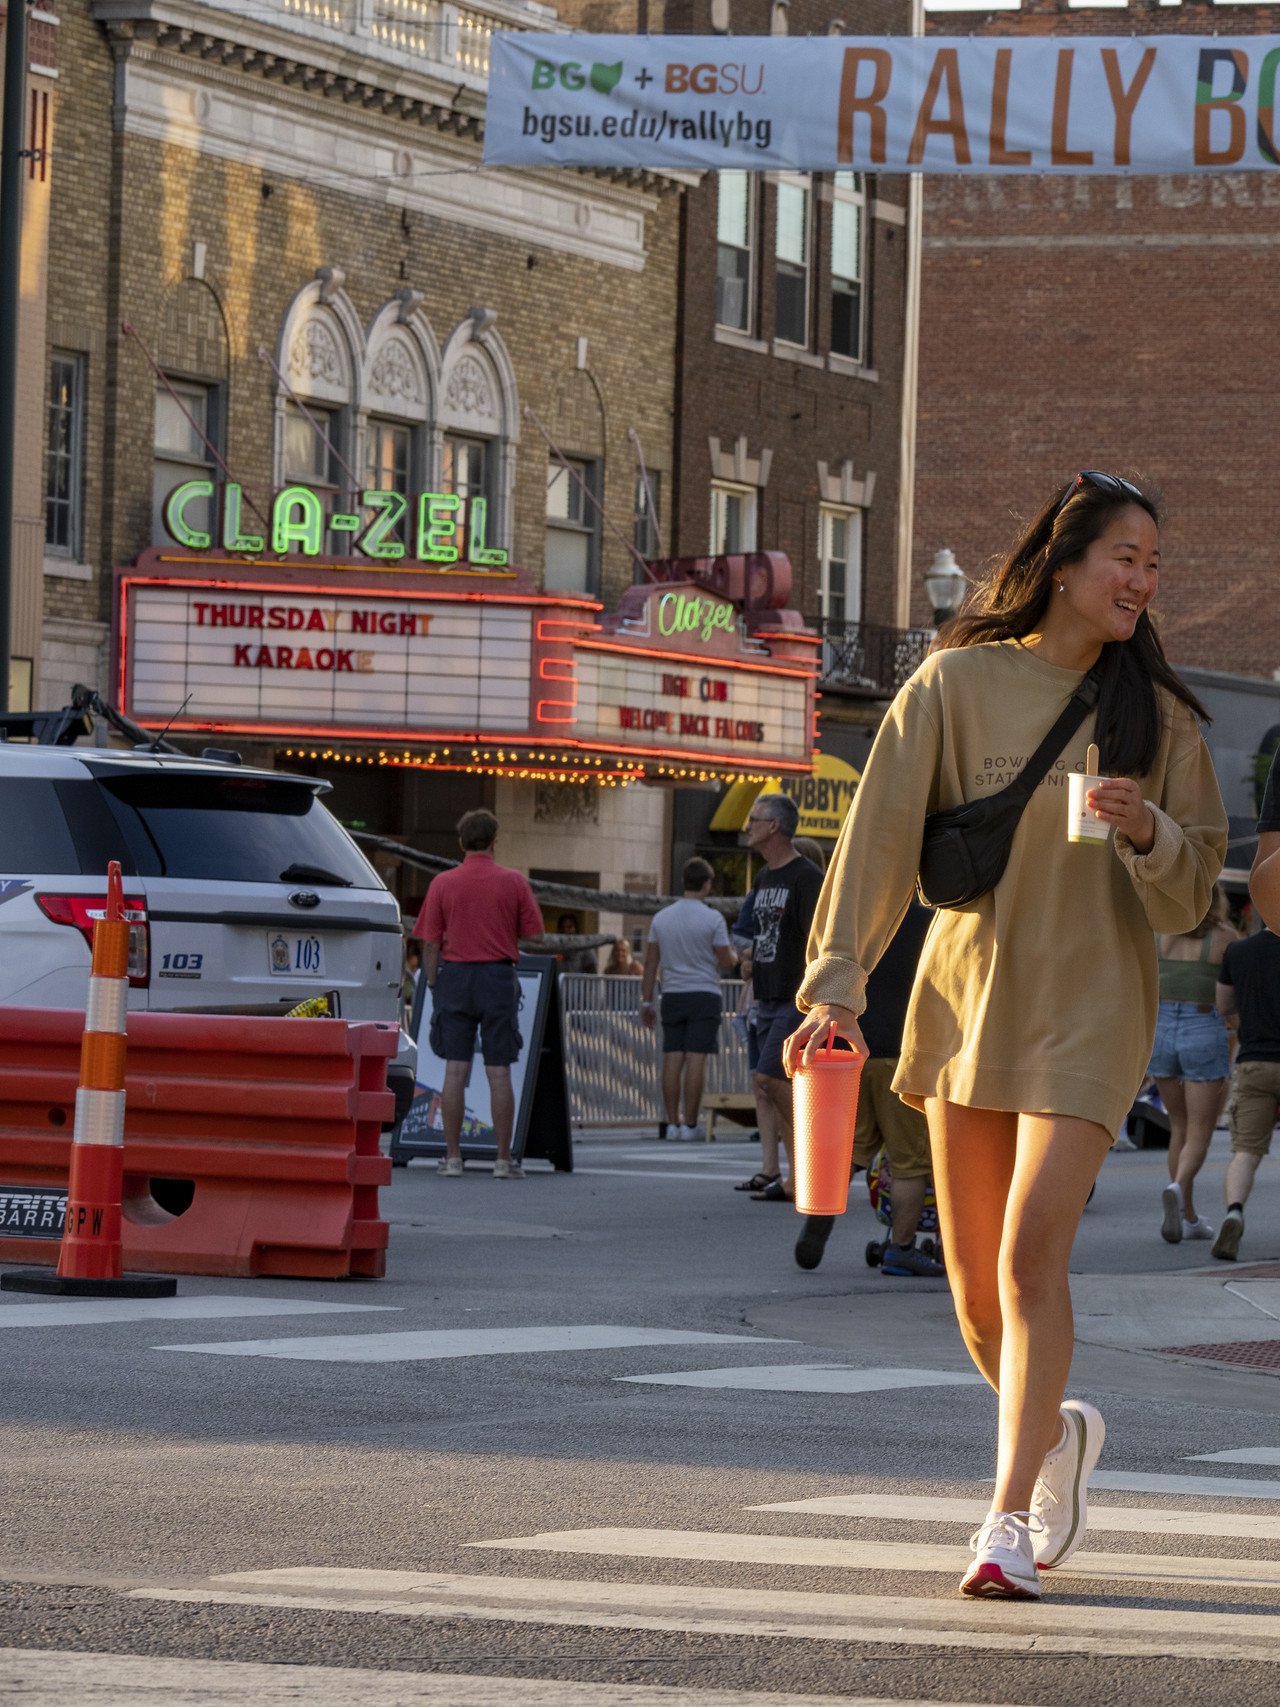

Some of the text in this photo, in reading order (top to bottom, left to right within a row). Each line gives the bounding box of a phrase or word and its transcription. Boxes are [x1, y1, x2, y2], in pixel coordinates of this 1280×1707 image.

[531, 60, 586, 91] BG
[664, 63, 764, 94] BGSU
[837, 47, 1158, 166] RALLY
[522, 106, 772, 148] bgsu.edu/rallybg
[164, 480, 509, 566] CLA-ZEL
[193, 602, 433, 639] THURSDAY NIGHT
[233, 643, 375, 674] KARAOKE
[975, 772, 1020, 786] STAT
[162, 953, 203, 970] 103
[295, 939, 320, 970] 103
[0, 1210, 66, 1228] BARRI
